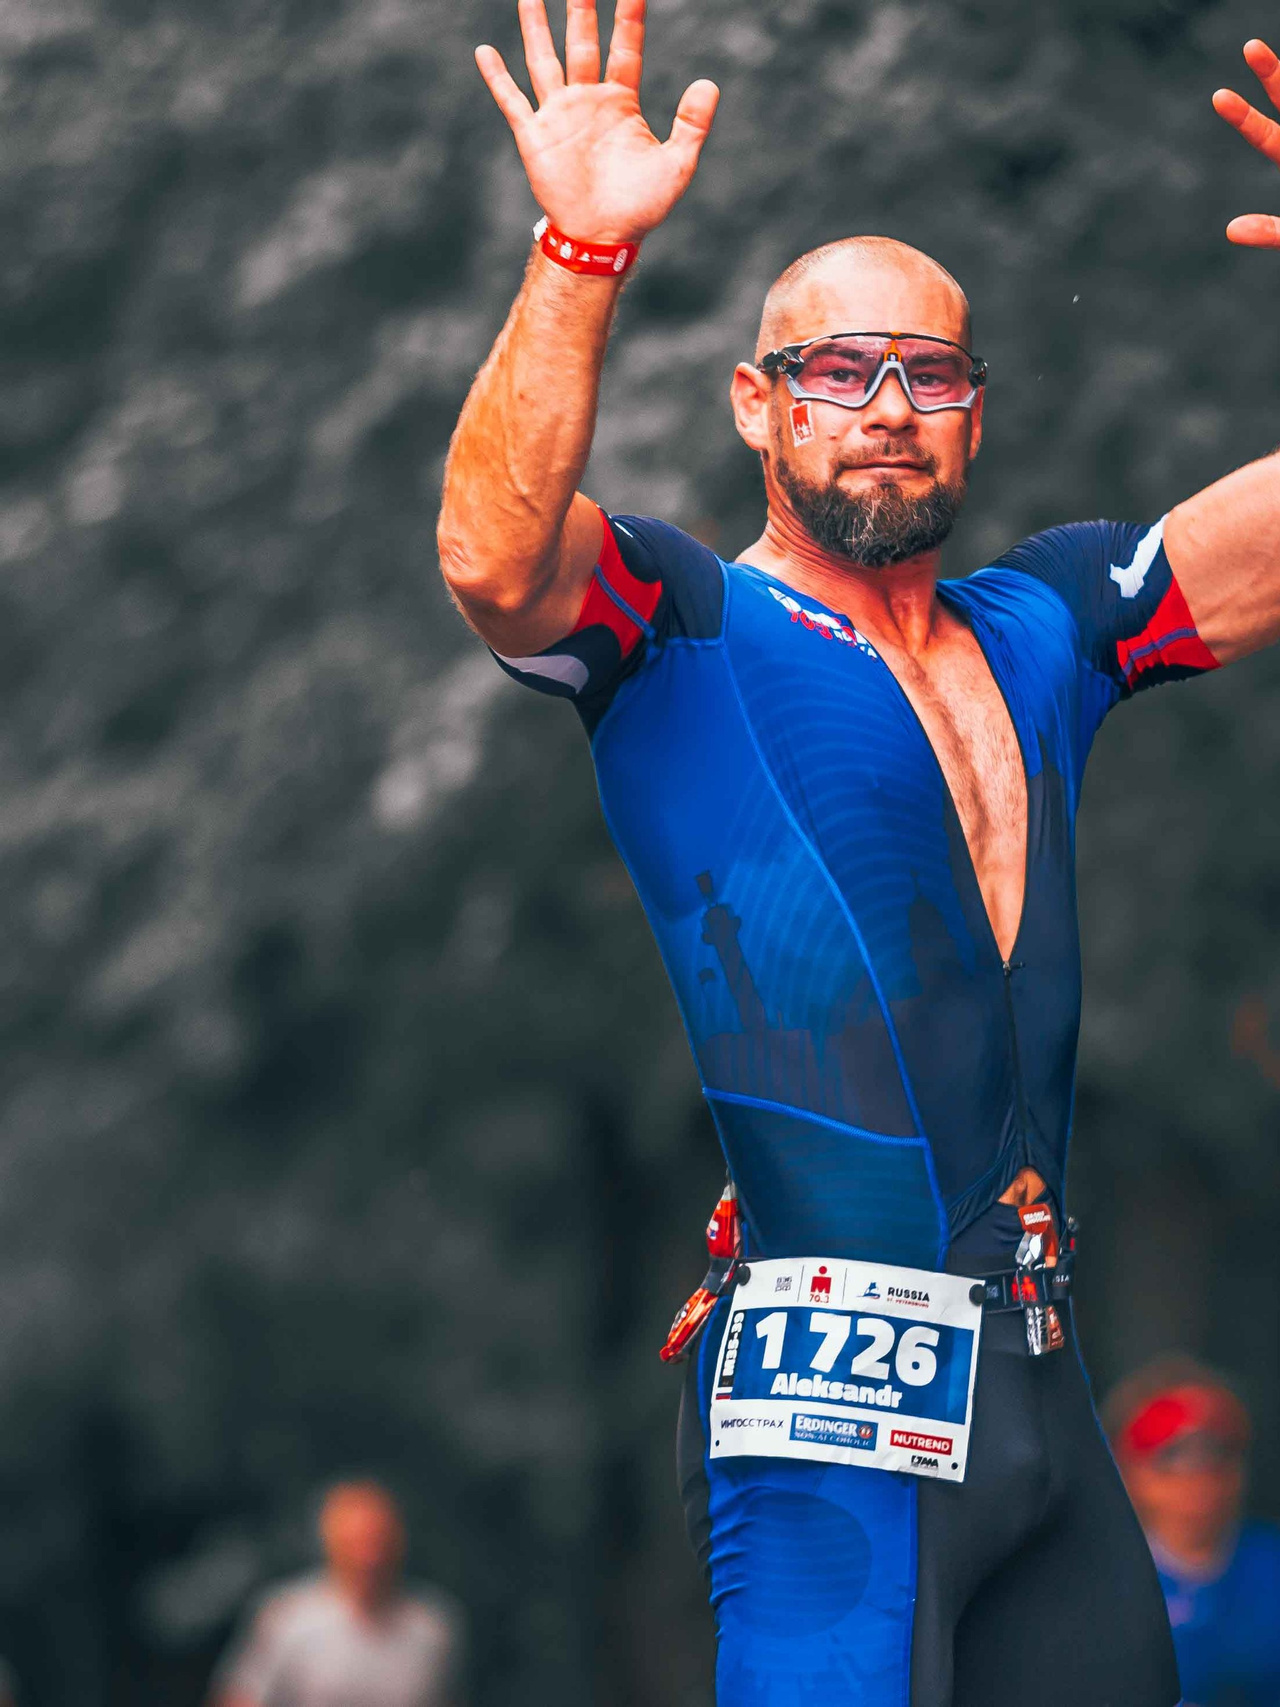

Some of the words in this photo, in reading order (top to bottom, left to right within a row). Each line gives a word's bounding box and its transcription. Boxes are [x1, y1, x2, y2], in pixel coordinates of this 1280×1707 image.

[887, 1286, 930, 1302] RUSSIA
[770, 1372, 902, 1408] Aleksandr
[721, 1417, 784, 1429] ИНГОССТРАХ
[795, 1414, 858, 1438] ERDINGER
[893, 1432, 950, 1452] NUTREND
